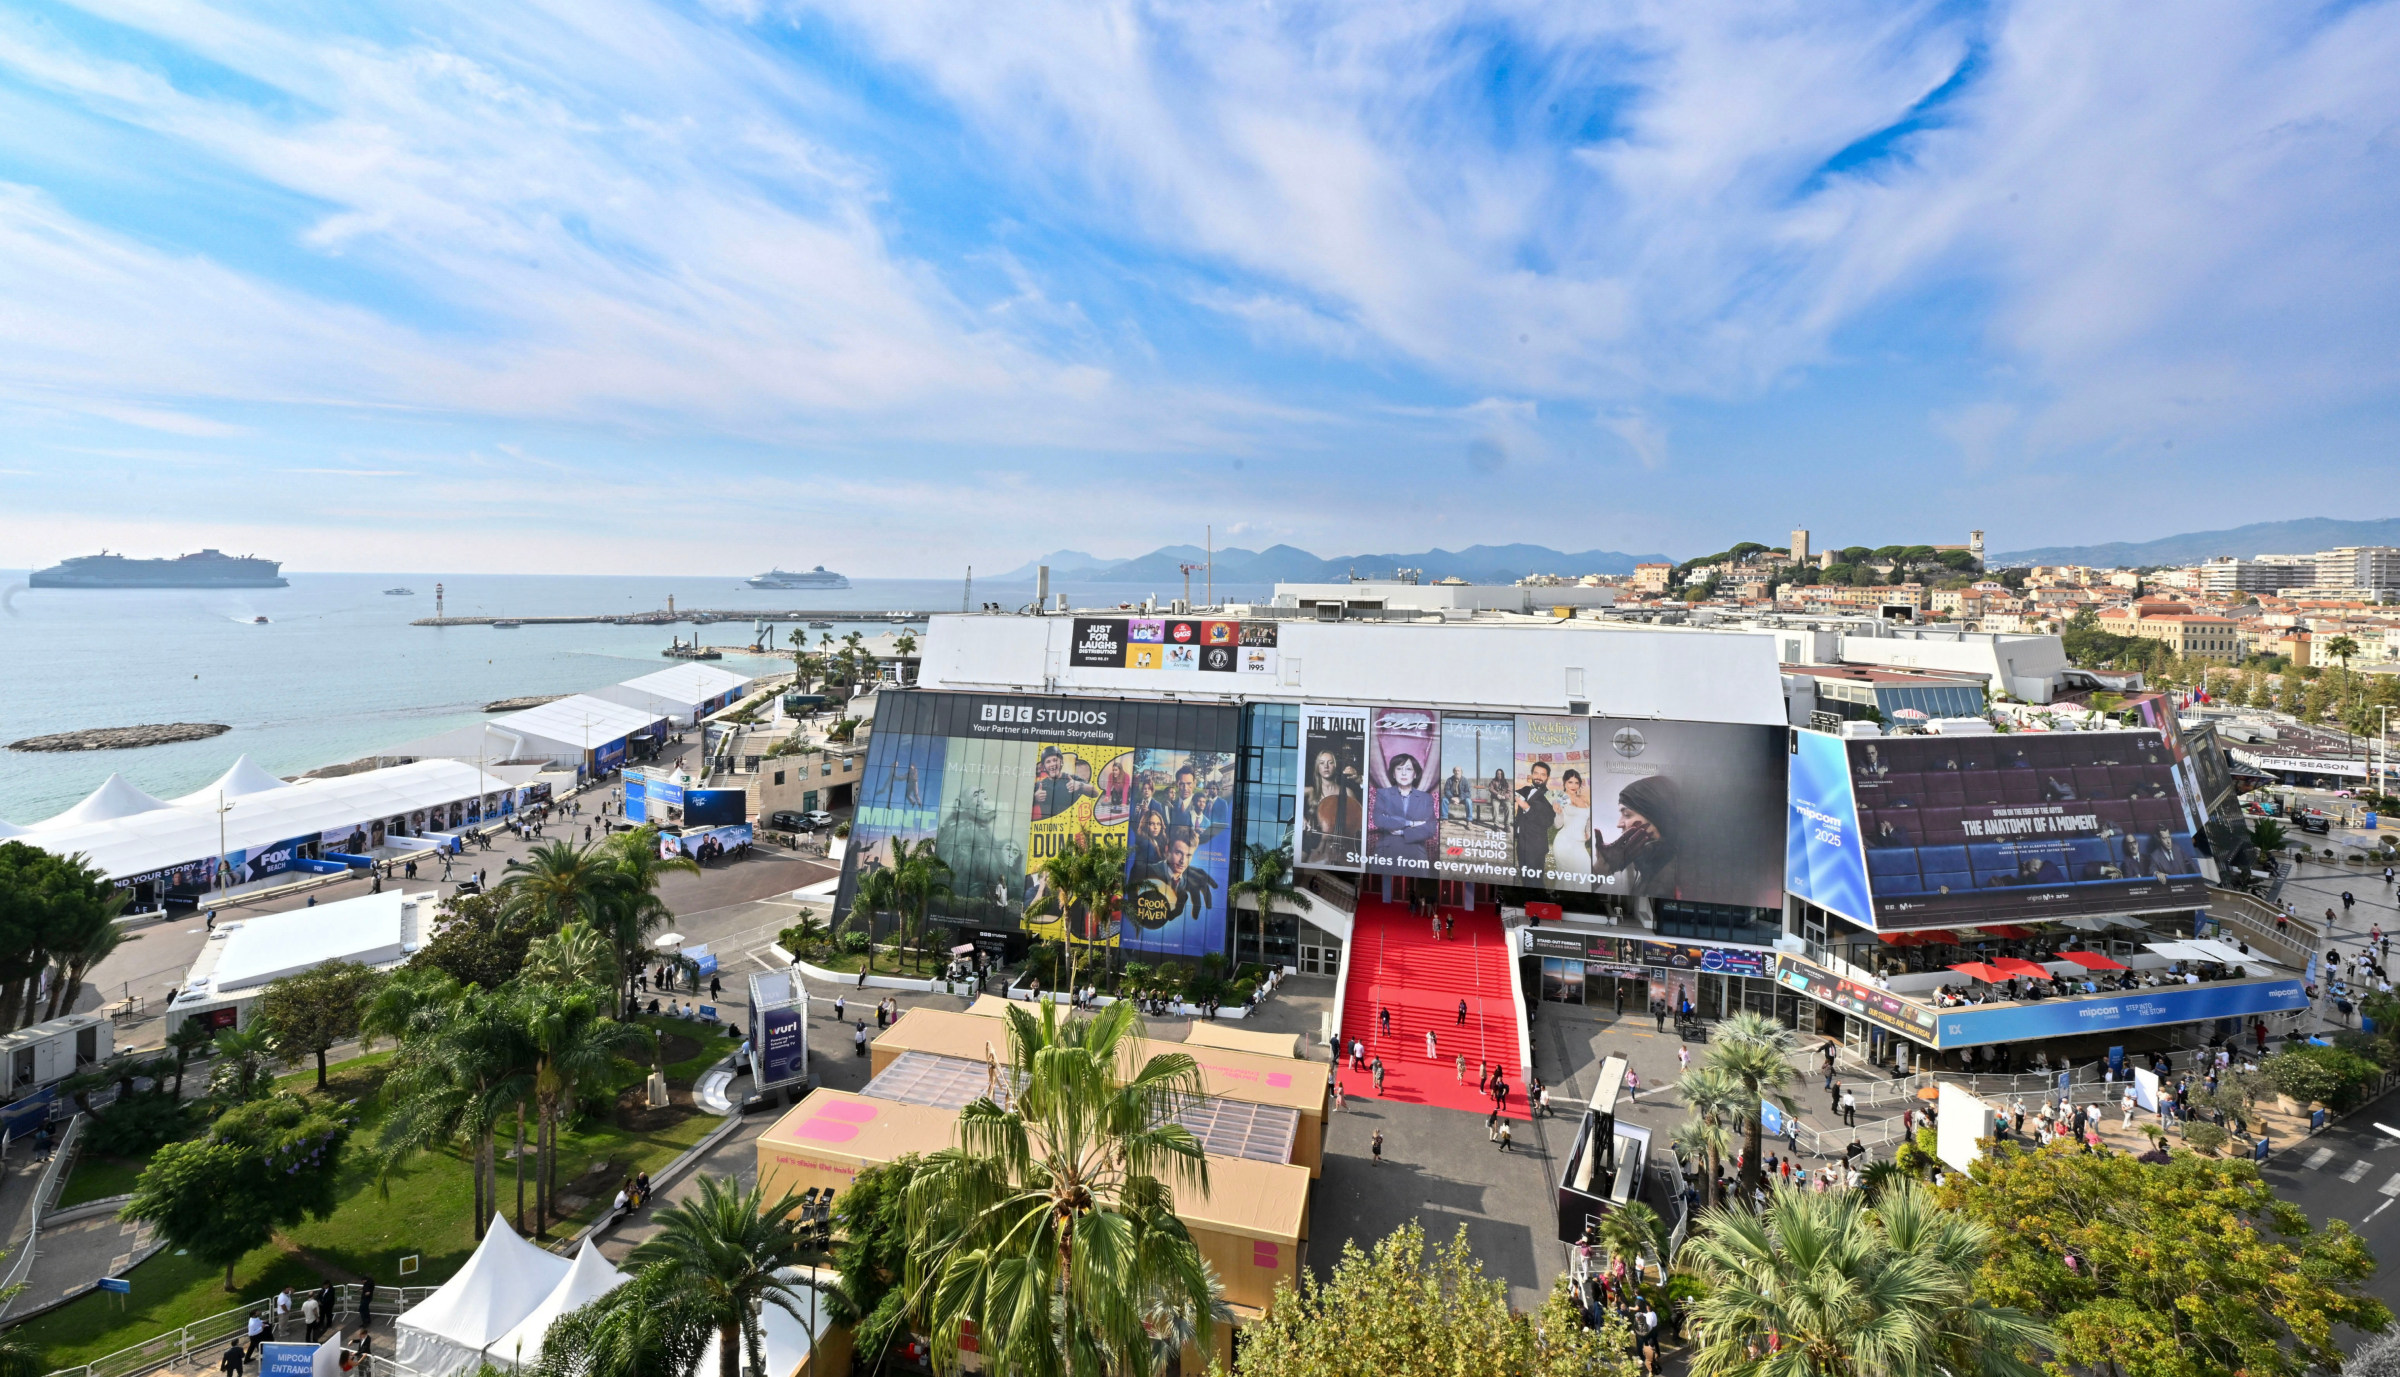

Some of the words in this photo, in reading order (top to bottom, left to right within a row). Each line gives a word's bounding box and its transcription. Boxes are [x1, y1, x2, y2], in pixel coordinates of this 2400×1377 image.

[1087, 625, 1112, 633] JUST
[1090, 633, 1108, 641] FOR
[1079, 641, 1117, 649] LAUGHS
[981, 704, 1033, 722] BBC
[1036, 709, 1107, 725] STUDIOS
[1307, 716, 1325, 730] THE
[1328, 717, 1366, 732] TALENT
[1527, 721, 1577, 738] Wedding
[973, 724, 990, 732] Your
[992, 726, 1019, 734] Partner
[1031, 728, 1065, 736] Premium
[1067, 729, 1114, 740] Storytelling
[1528, 732, 1578, 748] Registry
[948, 762, 1032, 777] MATRIARCH
[2262, 758, 2297, 767] FIFTH
[2300, 761, 2349, 771] SEASON
[457, 806, 514, 827] LIONSGATE
[858, 806, 936, 829] MINT
[1796, 805, 1841, 827] mipcom
[1993, 808, 2006, 817] SPAIN
[2006, 808, 2013, 816] ON
[2013, 808, 2022, 816] THE
[2049, 806, 2064, 814] ABYSS
[1034, 823, 1064, 832] NATION'S
[1822, 823, 1841, 832] CANNES
[1961, 820, 1983, 836] THE
[1984, 818, 2033, 835] ANATOMY
[2033, 816, 2047, 832] OF
[2049, 816, 2057, 831] A
[2056, 814, 2098, 830] MOMENT
[730, 828, 747, 836] Sins
[1484, 830, 1507, 841] THE
[1815, 828, 1841, 847] 2025
[1034, 833, 1125, 858] DUMEST
[1446, 837, 1507, 850] MEDIAPRO
[261, 848, 292, 867] FOX
[1464, 848, 1507, 859] STUDIO
[266, 861, 286, 873] BEACH
[1346, 852, 1393, 866] Stories
[1397, 855, 1430, 869] from
[1434, 858, 1517, 877] everywhere
[1521, 865, 1542, 879] for
[1546, 869, 1616, 885] everyone
[114, 877, 129, 889] ND
[132, 872, 161, 887] YOUR
[164, 862, 200, 877] STORY.
[1138, 898, 1167, 911] CROOK
[1138, 909, 1167, 920] HAVEN
[1804, 968, 1825, 979] UNIVERSAL
[2269, 988, 2298, 997] mipcom
[2079, 1006, 2119, 1018] mipcom
[2150, 1007, 2166, 1015] STORY
[769, 1021, 797, 1035] wurl
[1868, 1007, 1878, 1017] OUR
[1878, 1010, 1896, 1025] STORIES
[1895, 1019, 1905, 1029] ARE
[1904, 1022, 1931, 1039] UNIVERSAL
[776, 1155, 795, 1165] Let's
[797, 1159, 816, 1169] show
[819, 1162, 832, 1171] the
[834, 1166, 855, 1175] world
[277, 1353, 311, 1363] MIPCOM
